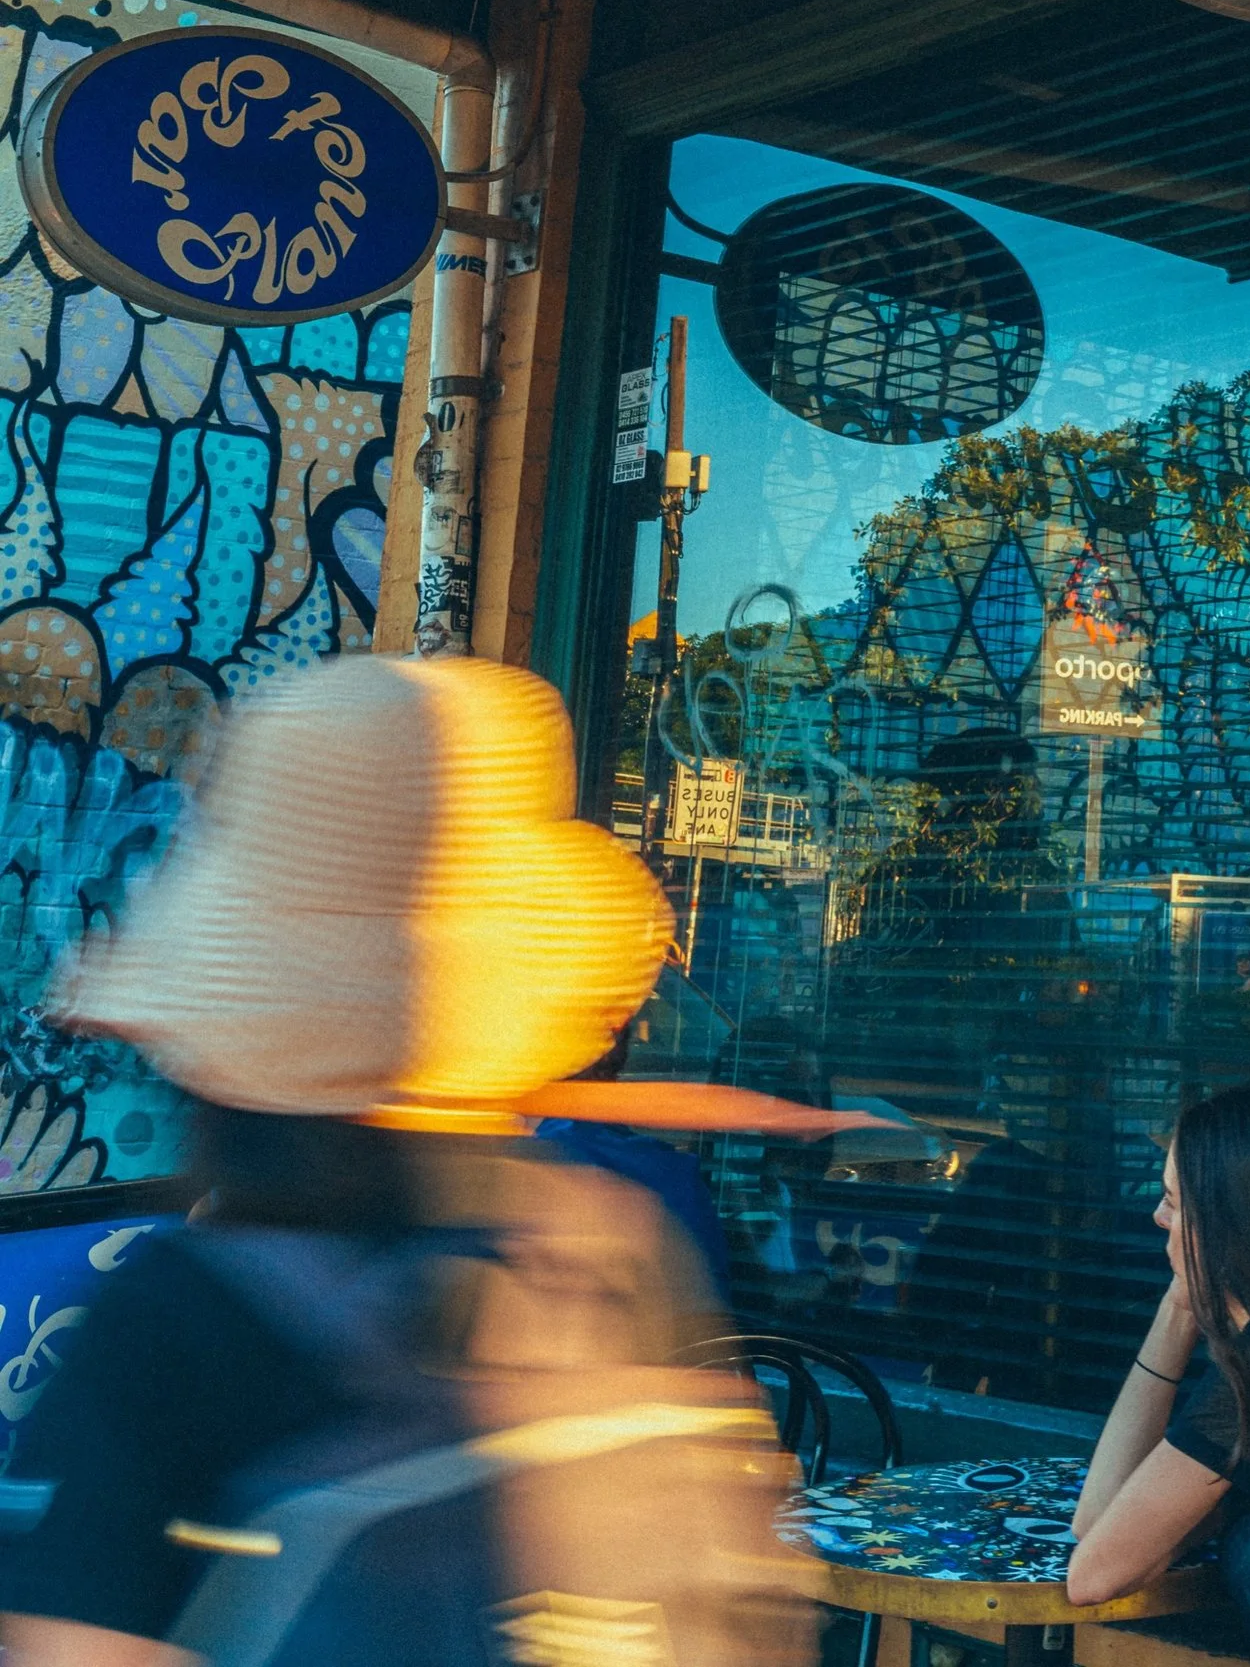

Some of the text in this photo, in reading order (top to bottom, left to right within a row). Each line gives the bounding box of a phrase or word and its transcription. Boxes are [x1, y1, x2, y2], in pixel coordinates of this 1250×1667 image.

[131, 54, 366, 304] Bar Planet
[621, 378, 650, 393] GLASS
[626, 429, 644, 444] GLASS
